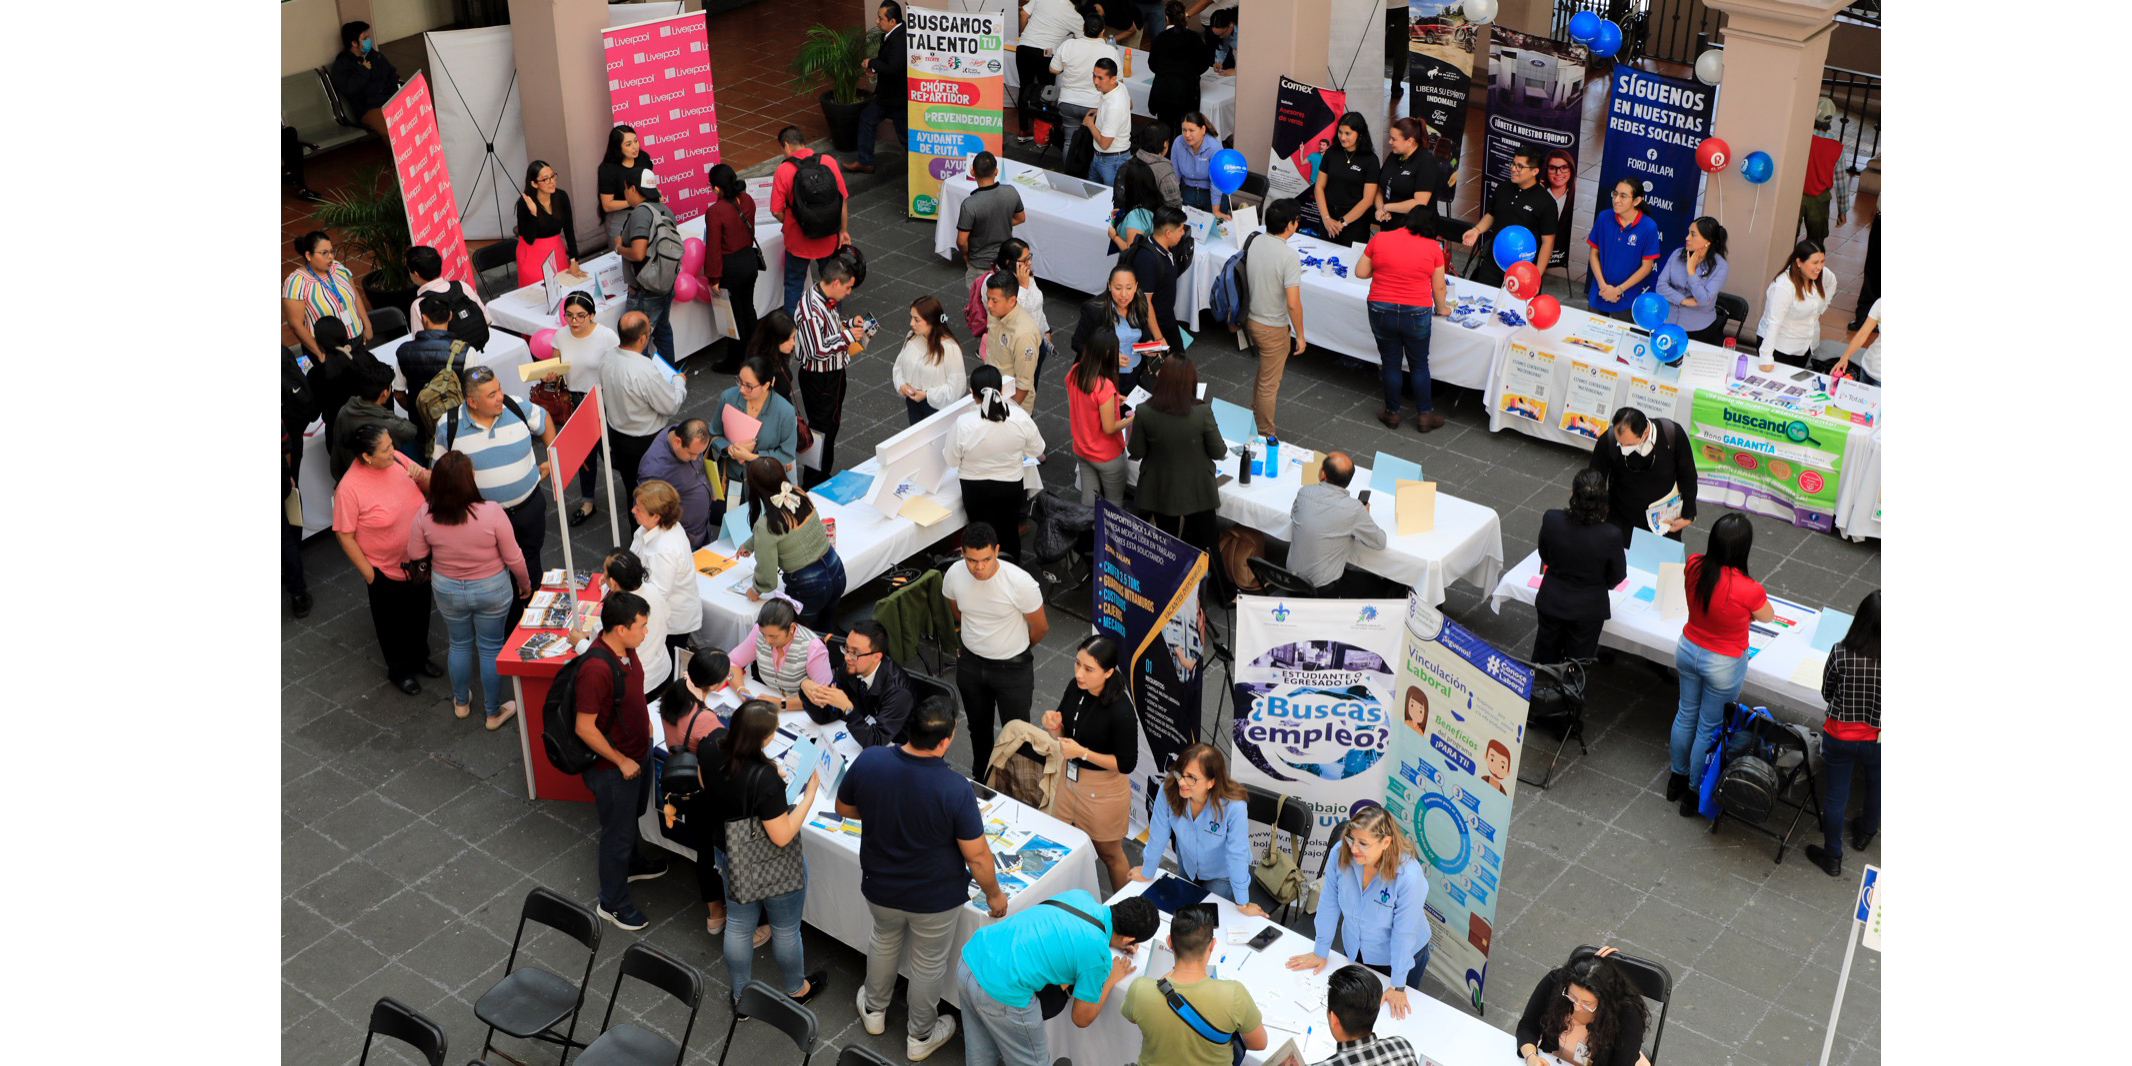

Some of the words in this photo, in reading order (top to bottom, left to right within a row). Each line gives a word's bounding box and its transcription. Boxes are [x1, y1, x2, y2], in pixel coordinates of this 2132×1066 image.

[672, 22, 706, 35] Liverpool
[908, 13, 992, 35] BUSCAMOS
[615, 32, 649, 46] Liverpool
[907, 33, 978, 54] TALENTO
[982, 37, 996, 49] TU
[646, 47, 680, 62] Liverpool
[677, 63, 710, 77] Liverpool
[620, 74, 655, 88] Liverpool
[921, 80, 959, 94] CHÓFER
[651, 88, 685, 103] Liverpool
[911, 90, 970, 104] REPARTIDOR
[1618, 74, 1705, 111] SÍGUENOS
[681, 104, 714, 118] Liverpool
[1432, 110, 1448, 121] Ford
[1614, 98, 1631, 115] EN
[1633, 103, 1703, 132] NUESTRAS
[925, 112, 1003, 128] PREVENDEDOR/A
[656, 129, 689, 144] Liverpool
[917, 132, 964, 145] AYUDANTE
[1513, 125, 1517, 133] A
[1518, 127, 1542, 139] NUESTRO
[1544, 132, 1568, 144] EQUIPO!
[1610, 116, 1645, 136] REDES
[1647, 126, 1701, 149] SOCIALES
[686, 144, 719, 158] Liverpool
[920, 144, 932, 154] DE
[934, 145, 958, 156] RUTA
[1627, 158, 1646, 171] FORD
[1647, 163, 1674, 178] JALAPA
[661, 169, 694, 184] Liverpool
[1704, 430, 1721, 440] Bono
[1723, 434, 1775, 455] GARANTÍA
[1157, 544, 1176, 561] TRASLADO
[1146, 658, 1152, 674] 01
[1409, 644, 1466, 694] Vinculación
[1282, 671, 1350, 680] ESTUDIANTE
[1284, 678, 1342, 686] EGRESADO
[1345, 678, 1360, 686] UV
[1407, 659, 1452, 699] Laboral
[1499, 672, 1524, 694] Laboral
[1252, 696, 1381, 723] ¿Buscas
[1249, 722, 1389, 750] empleo?
[1435, 715, 1478, 750] Beneficios
[1438, 729, 1446, 738] del
[1447, 736, 1472, 757] programa
[1435, 741, 1457, 760] ¡PARA
[1460, 755, 1469, 768] TI!
[1456, 788, 1460, 797] 3
[1320, 816, 1347, 827] UV
[1470, 817, 1475, 825] 4
[1473, 864, 1479, 873] 2
